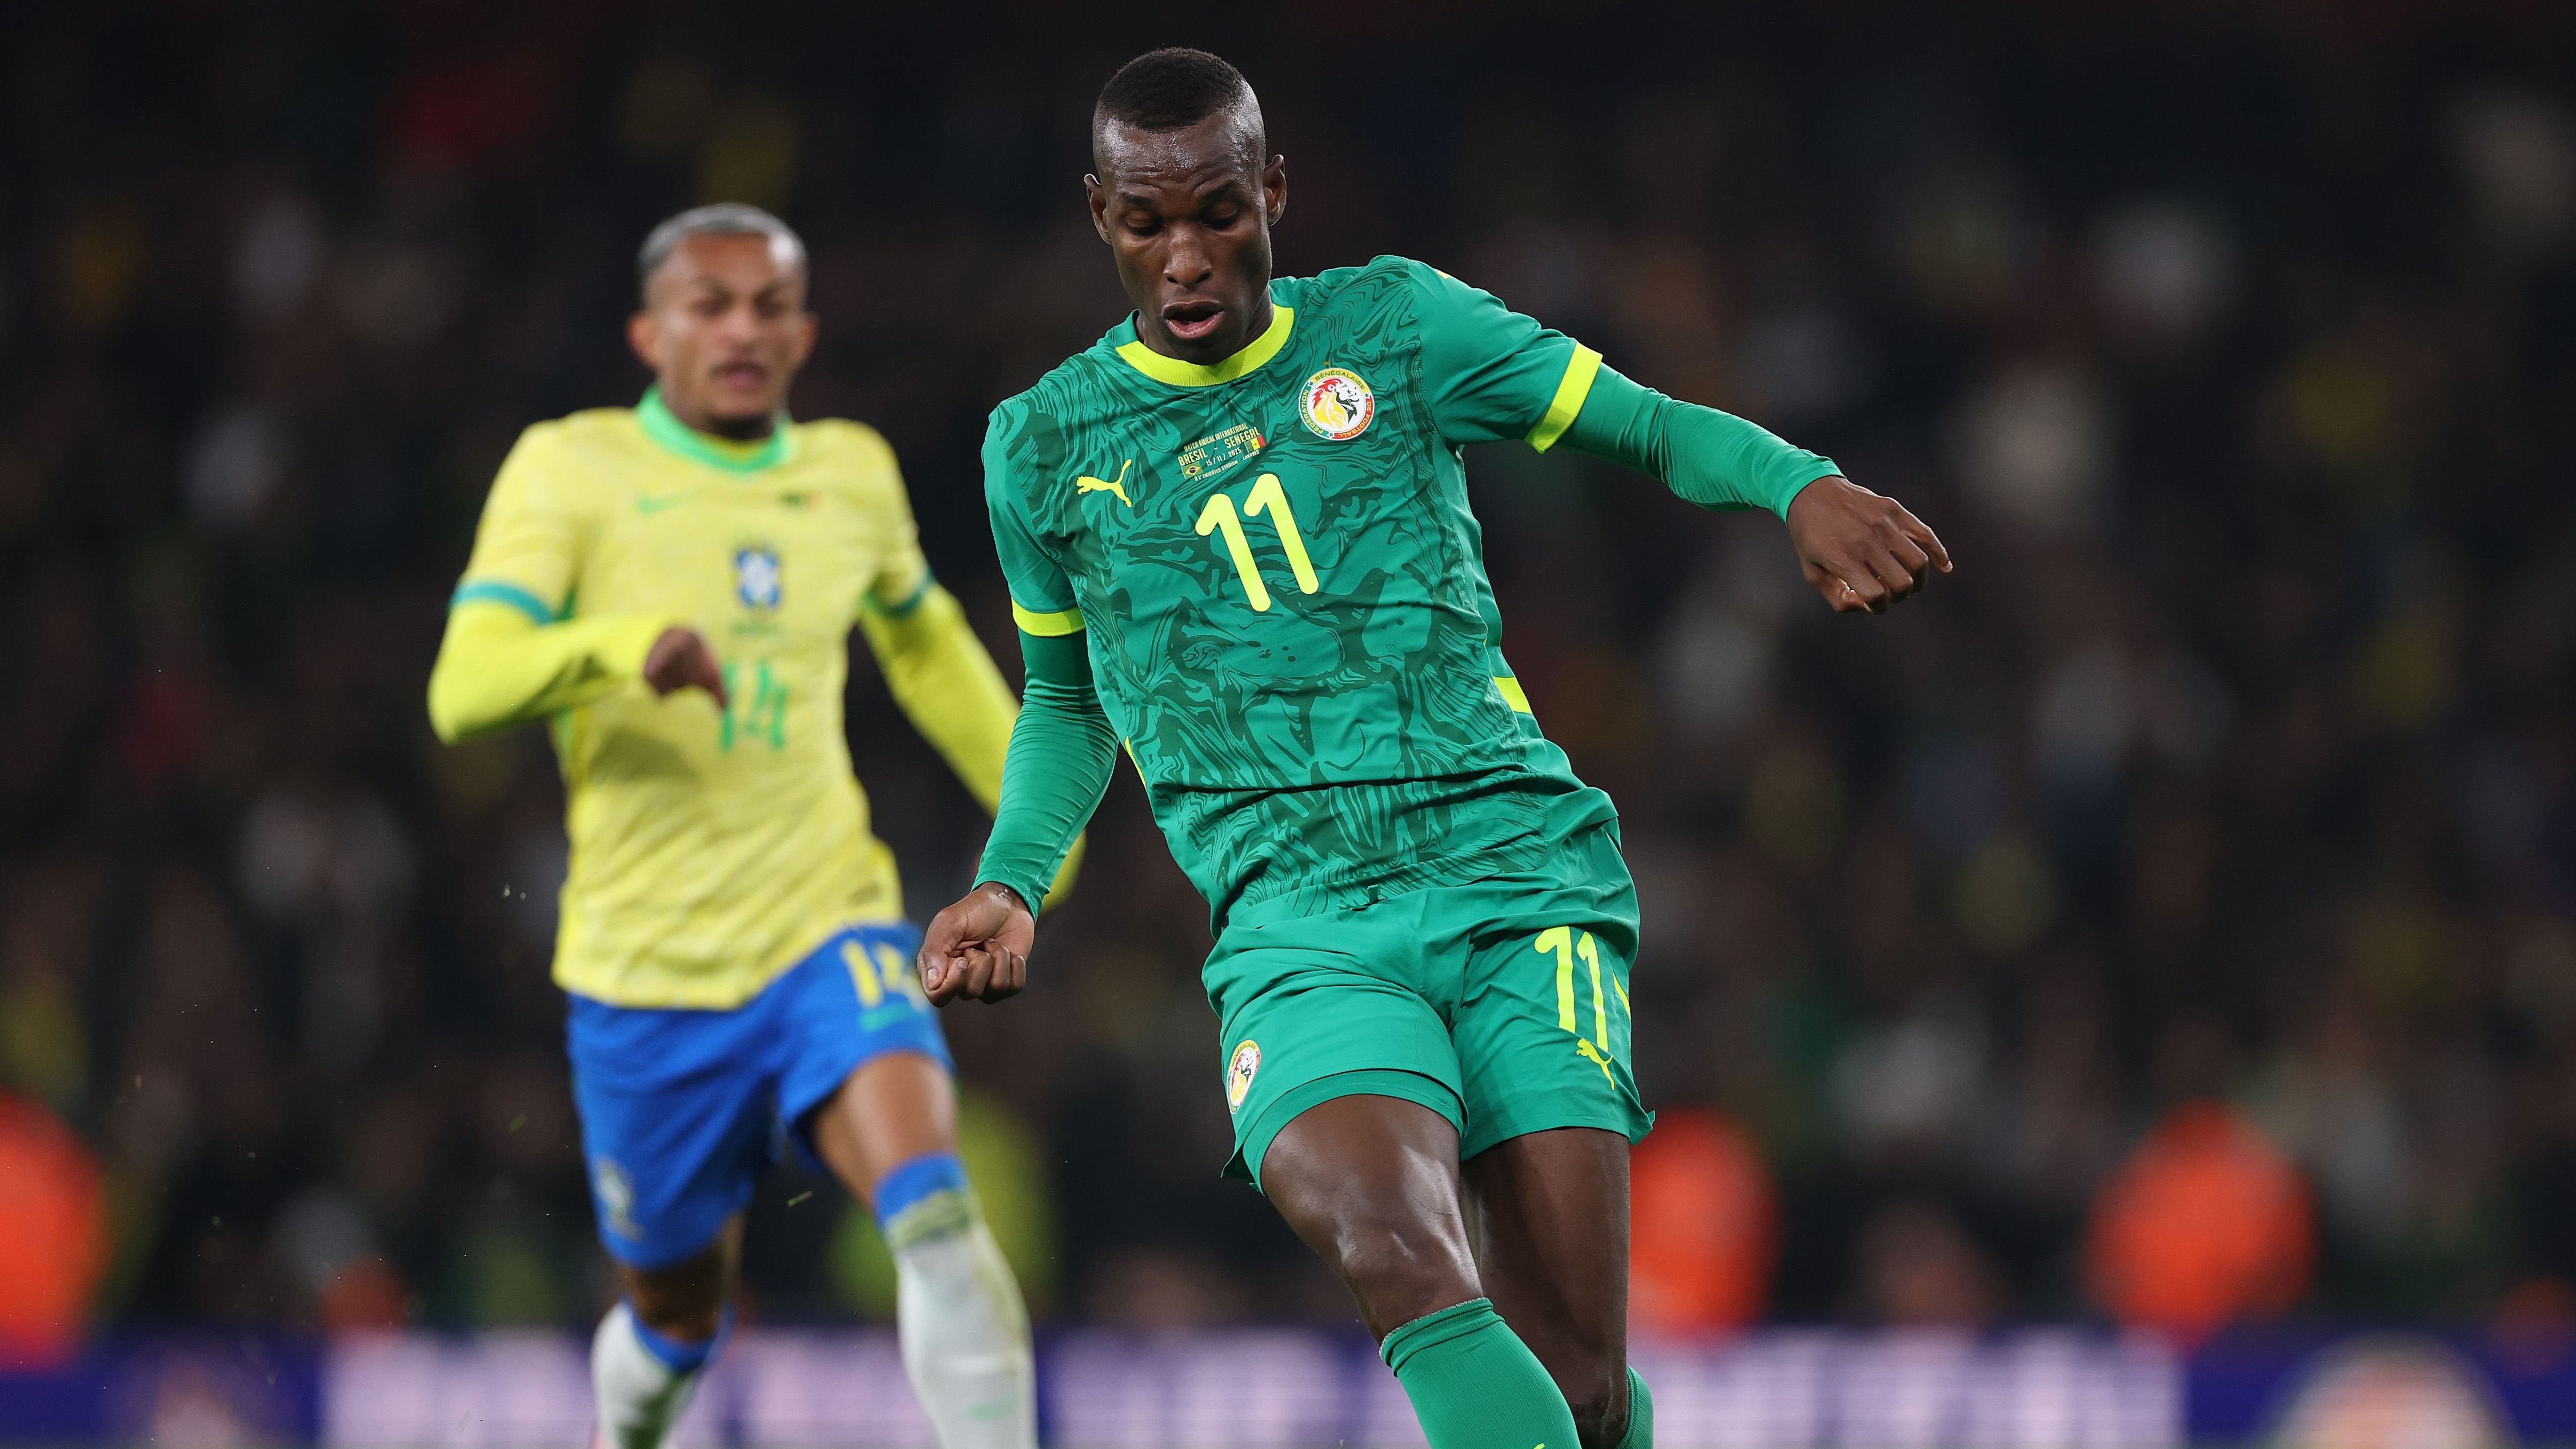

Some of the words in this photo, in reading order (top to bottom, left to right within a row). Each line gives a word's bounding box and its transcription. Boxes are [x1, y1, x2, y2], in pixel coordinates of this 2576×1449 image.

[1366, 401, 1372, 412] DE
[1183, 441, 1199, 452] MATCH
[1198, 435, 1216, 447] AMICAL
[1215, 422, 1248, 440] INTERNATIONAL
[1338, 413, 1370, 438] FOOTBALL
[1177, 448, 1208, 466] BRESIL
[1224, 427, 1261, 449] SENEGAL
[1228, 447, 1242, 458] 2025
[1195, 473, 1319, 612] 11
[721, 657, 789, 752] 14
[1534, 926, 1608, 1052] 11
